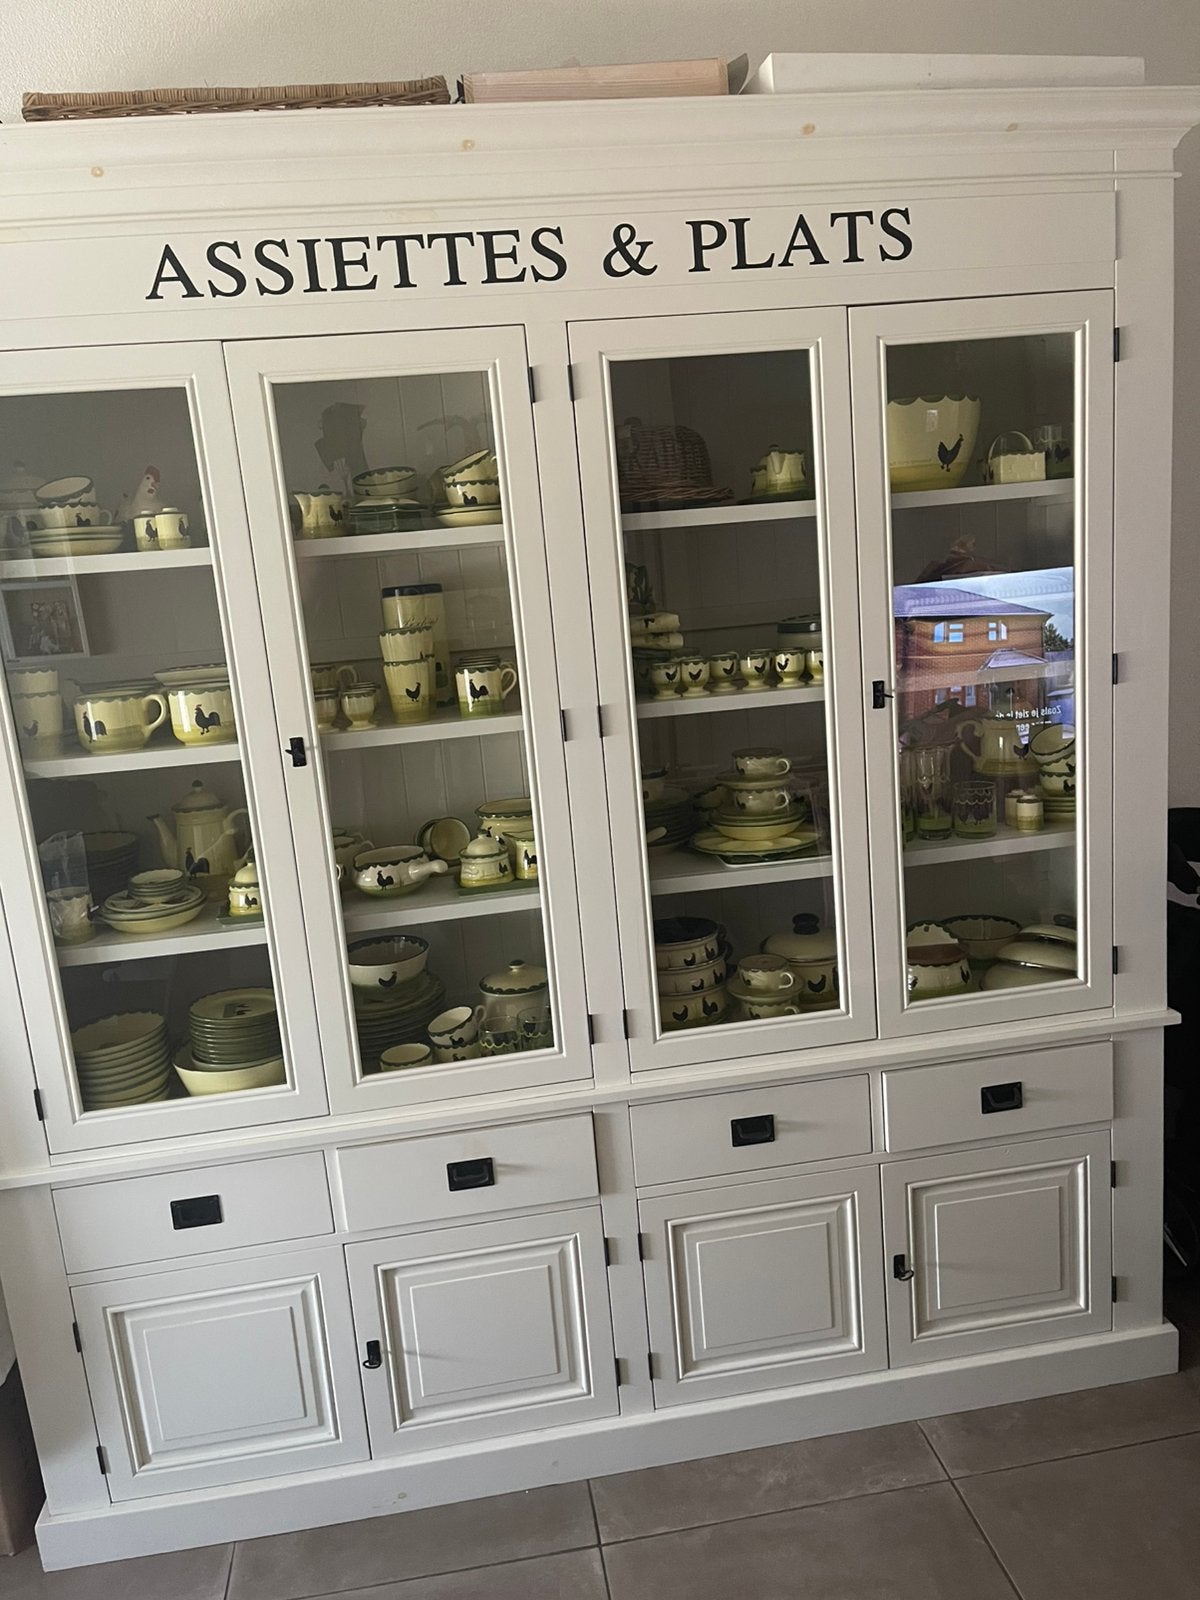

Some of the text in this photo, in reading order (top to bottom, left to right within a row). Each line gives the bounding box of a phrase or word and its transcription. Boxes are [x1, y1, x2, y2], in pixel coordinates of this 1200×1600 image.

[146, 208, 912, 299] ASSIETTES & PLATS
